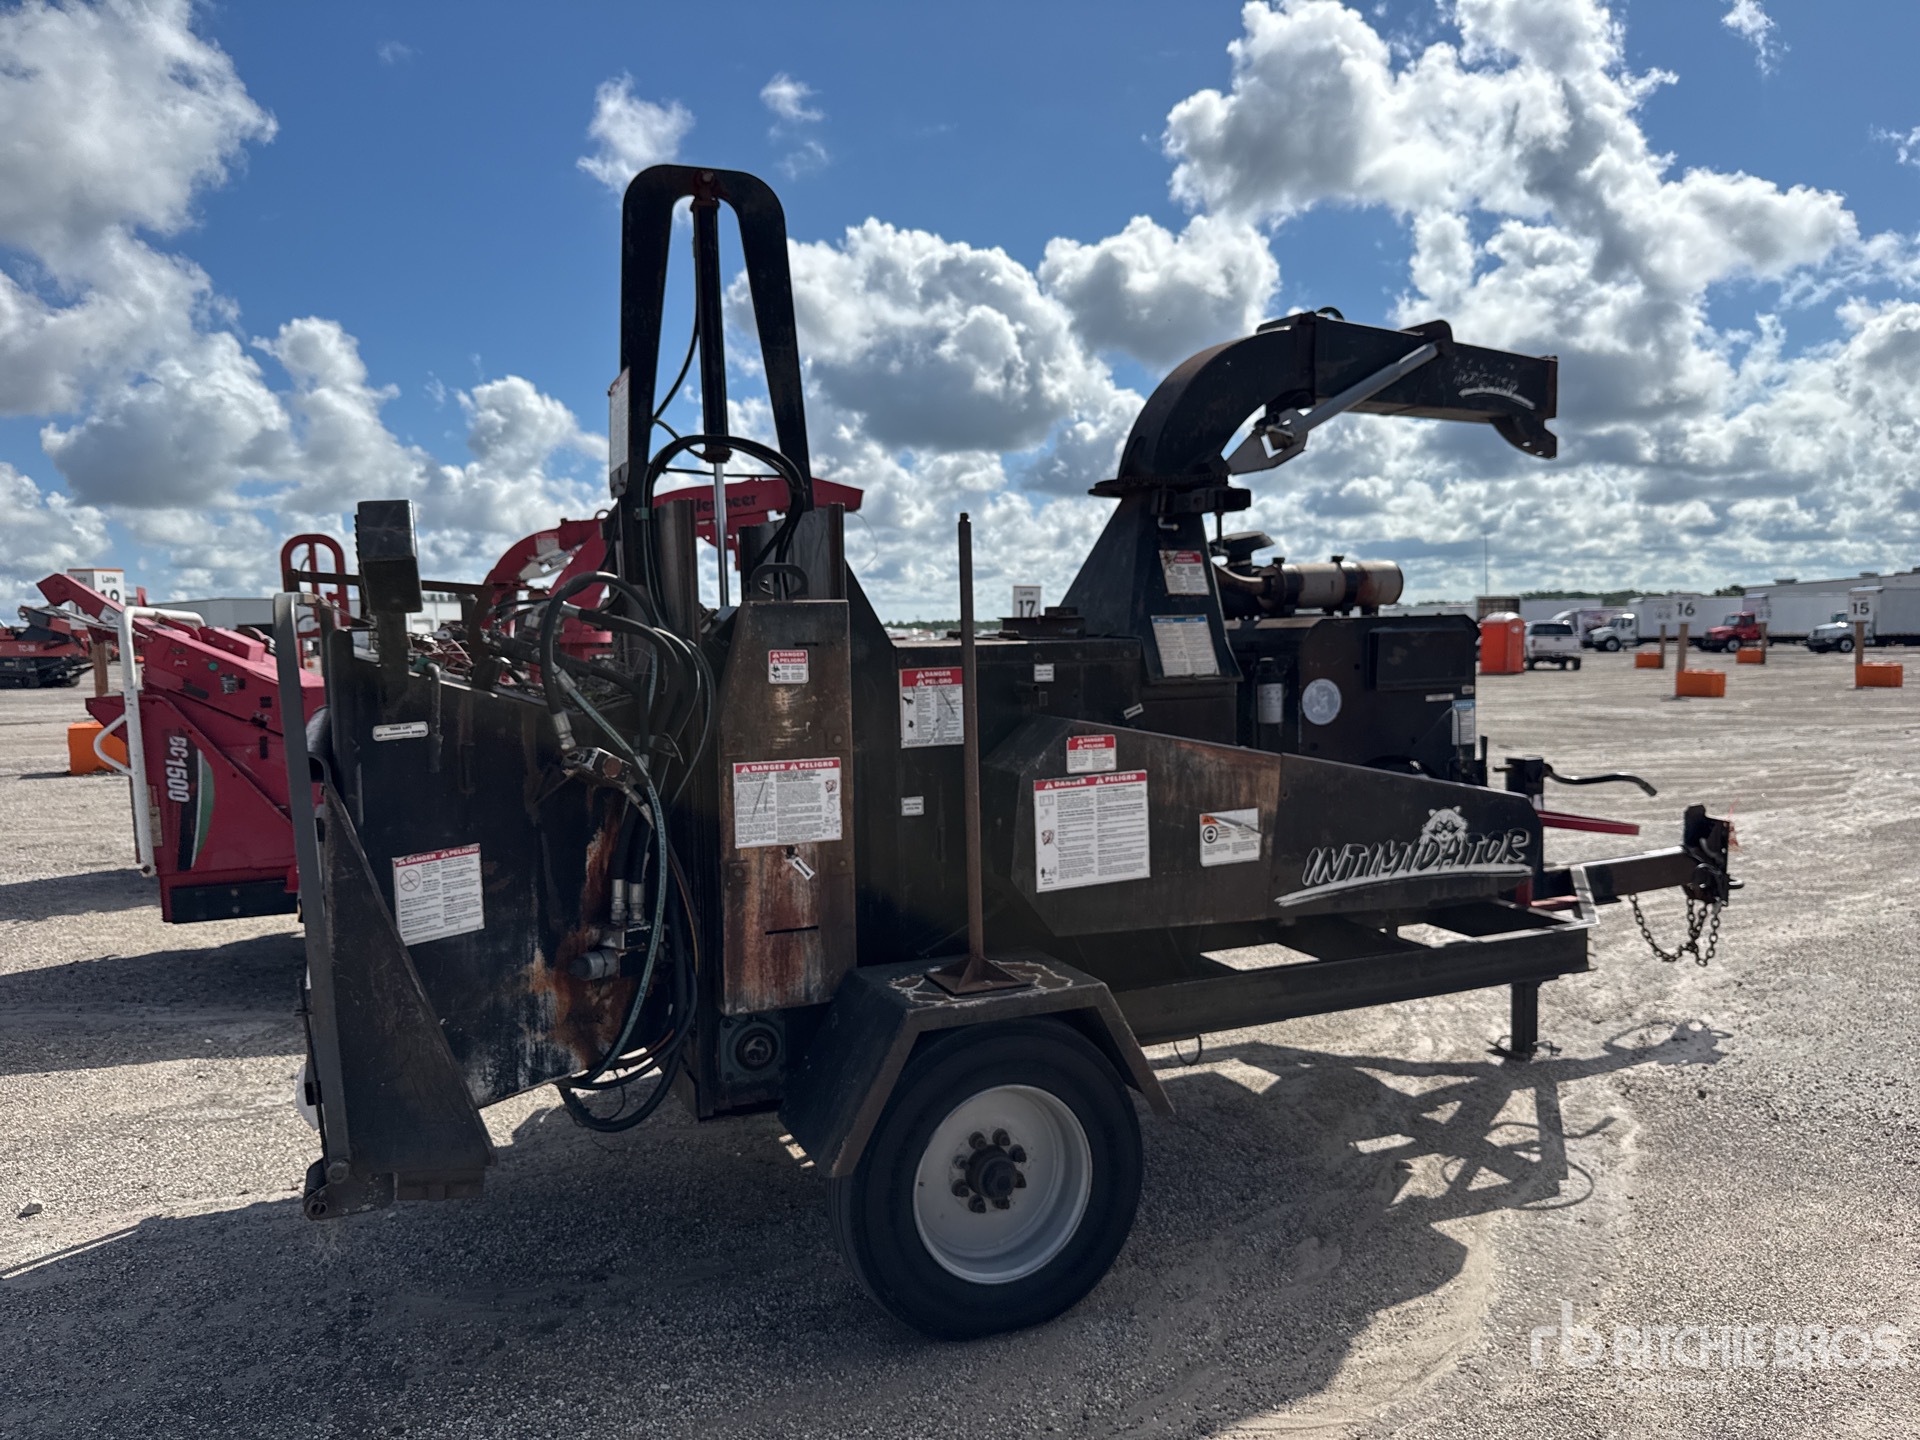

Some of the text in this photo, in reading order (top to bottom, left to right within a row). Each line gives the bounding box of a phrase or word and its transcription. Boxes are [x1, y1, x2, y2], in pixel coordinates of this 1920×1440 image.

[101, 575, 117, 583] Lane
[1018, 600, 1036, 618] 17
[1676, 601, 1695, 617] 16
[1852, 602, 1869, 615] 15
[165, 735, 190, 802] BC1500
[751, 761, 834, 771] DANGER PELIGRO
[1104, 774, 1137, 783] PELIGRO
[406, 846, 479, 863] DANGER PELIGRO
[1302, 828, 1531, 886] INTIMIDATOR
